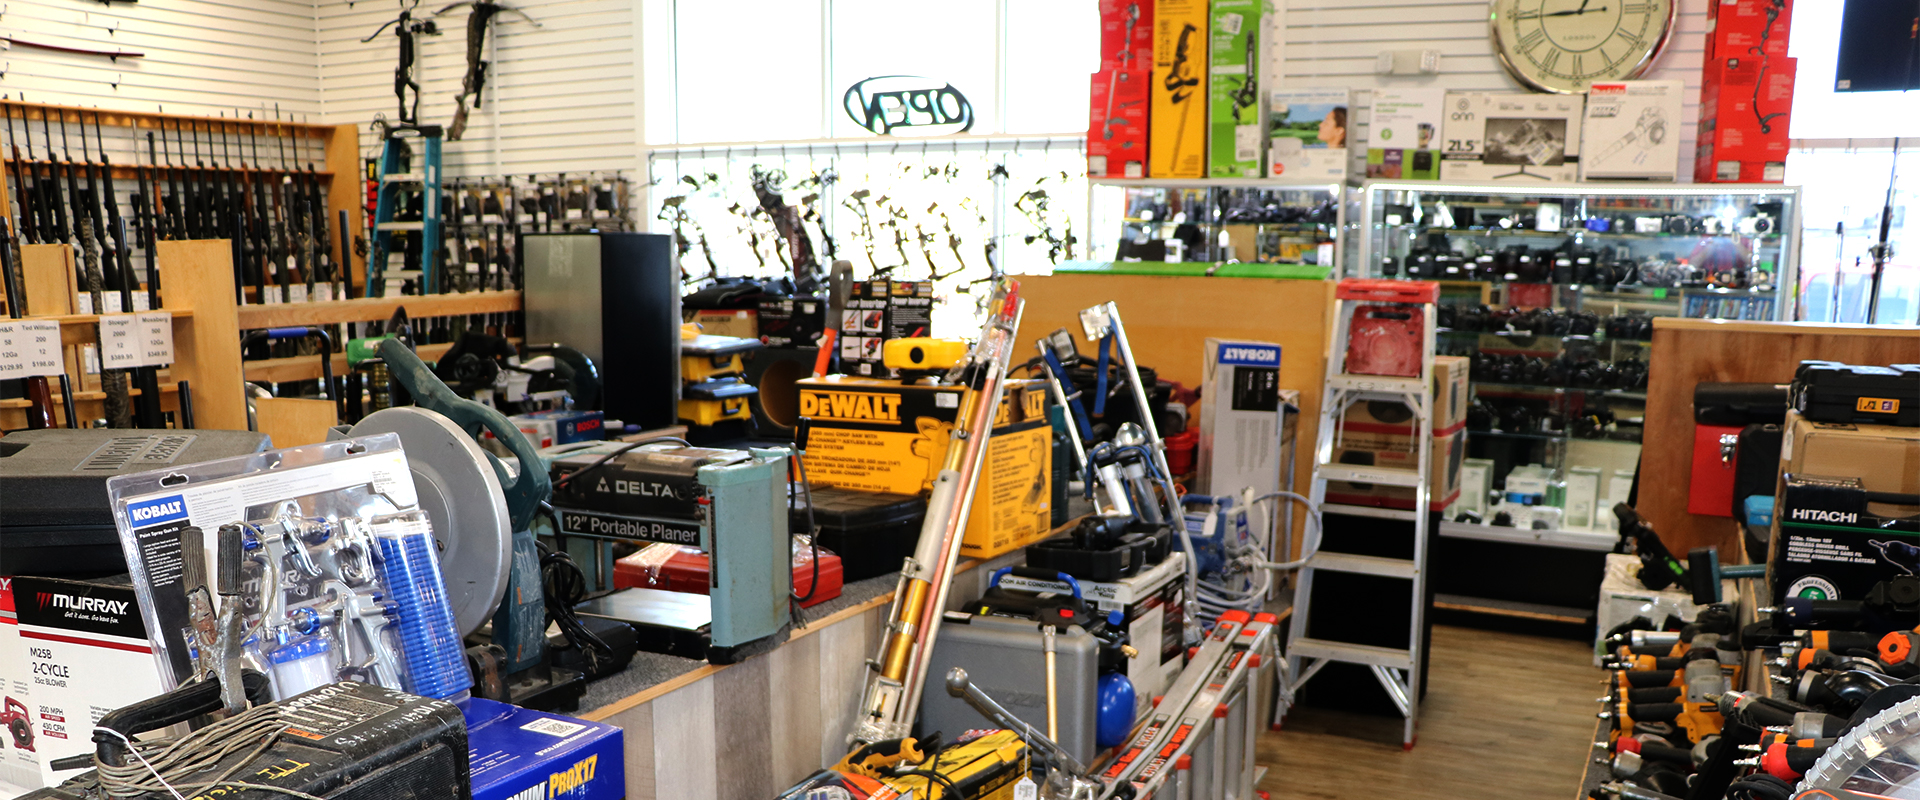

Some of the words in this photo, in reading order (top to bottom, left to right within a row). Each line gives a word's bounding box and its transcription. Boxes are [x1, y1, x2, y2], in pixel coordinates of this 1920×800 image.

[1448, 140, 1474, 151] 21.5
[847, 300, 859, 308] ower
[1223, 348, 1276, 362] KOBALT
[576, 419, 600, 433] BOSCH
[615, 480, 674, 498] DELTA
[132, 501, 182, 521] KOBALT
[1792, 508, 1857, 524] HITACHI
[590, 517, 649, 538] Portable
[651, 524, 697, 542] Planer
[1028, 580, 1071, 590] CONDITIONER
[1094, 585, 1117, 593] Arctic
[1798, 580, 1836, 599] PROFESSIONA
[30, 647, 52, 659] M25B
[32, 662, 69, 678] 2-CYCLE
[46, 679, 67, 688] BLOWER
[39, 705, 49, 713] 200
[50, 706, 63, 715] MPH
[53, 724, 66, 732] CFM
